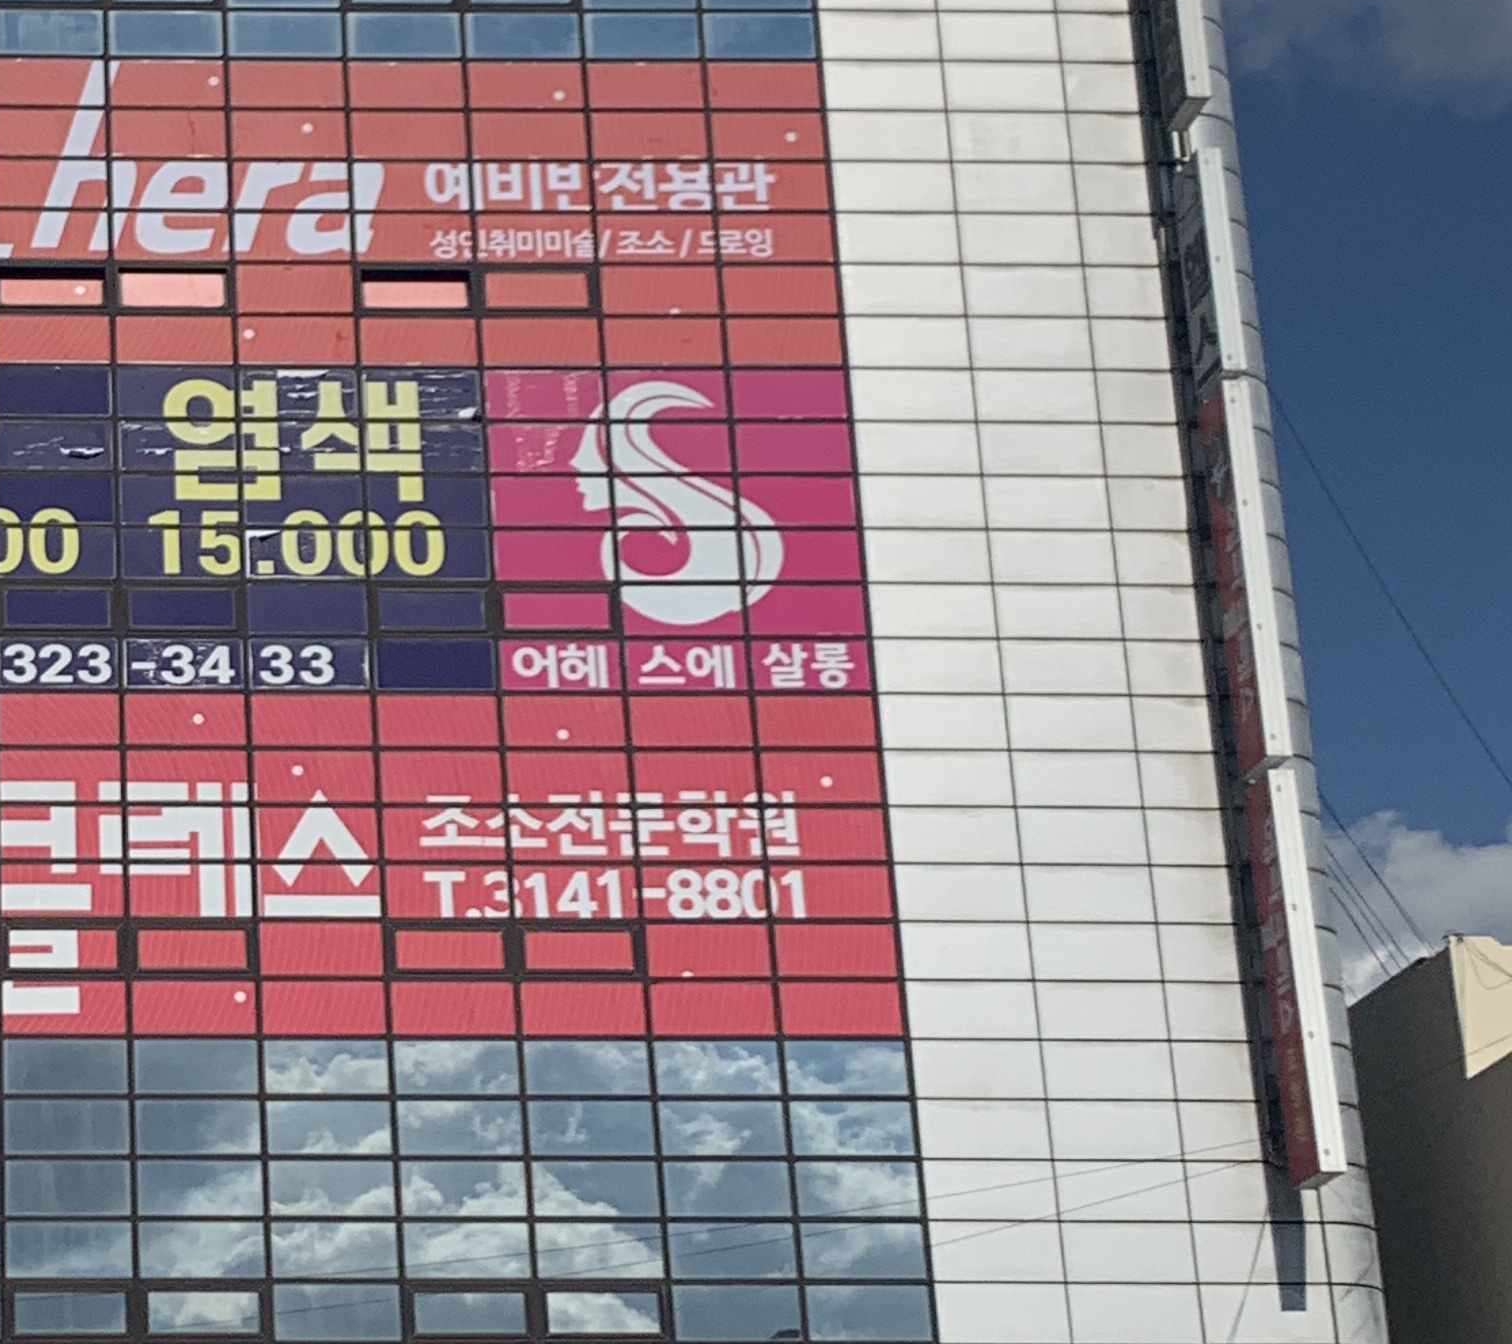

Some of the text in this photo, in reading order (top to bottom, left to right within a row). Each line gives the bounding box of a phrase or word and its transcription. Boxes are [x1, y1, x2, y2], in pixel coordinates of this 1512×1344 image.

[162, 378, 425, 502] 염색
[147, 509, 446, 576] 15.000
[511, 643, 855, 688] 어헤 스에 살롱
[419, 789, 801, 856] 조소전문학원
